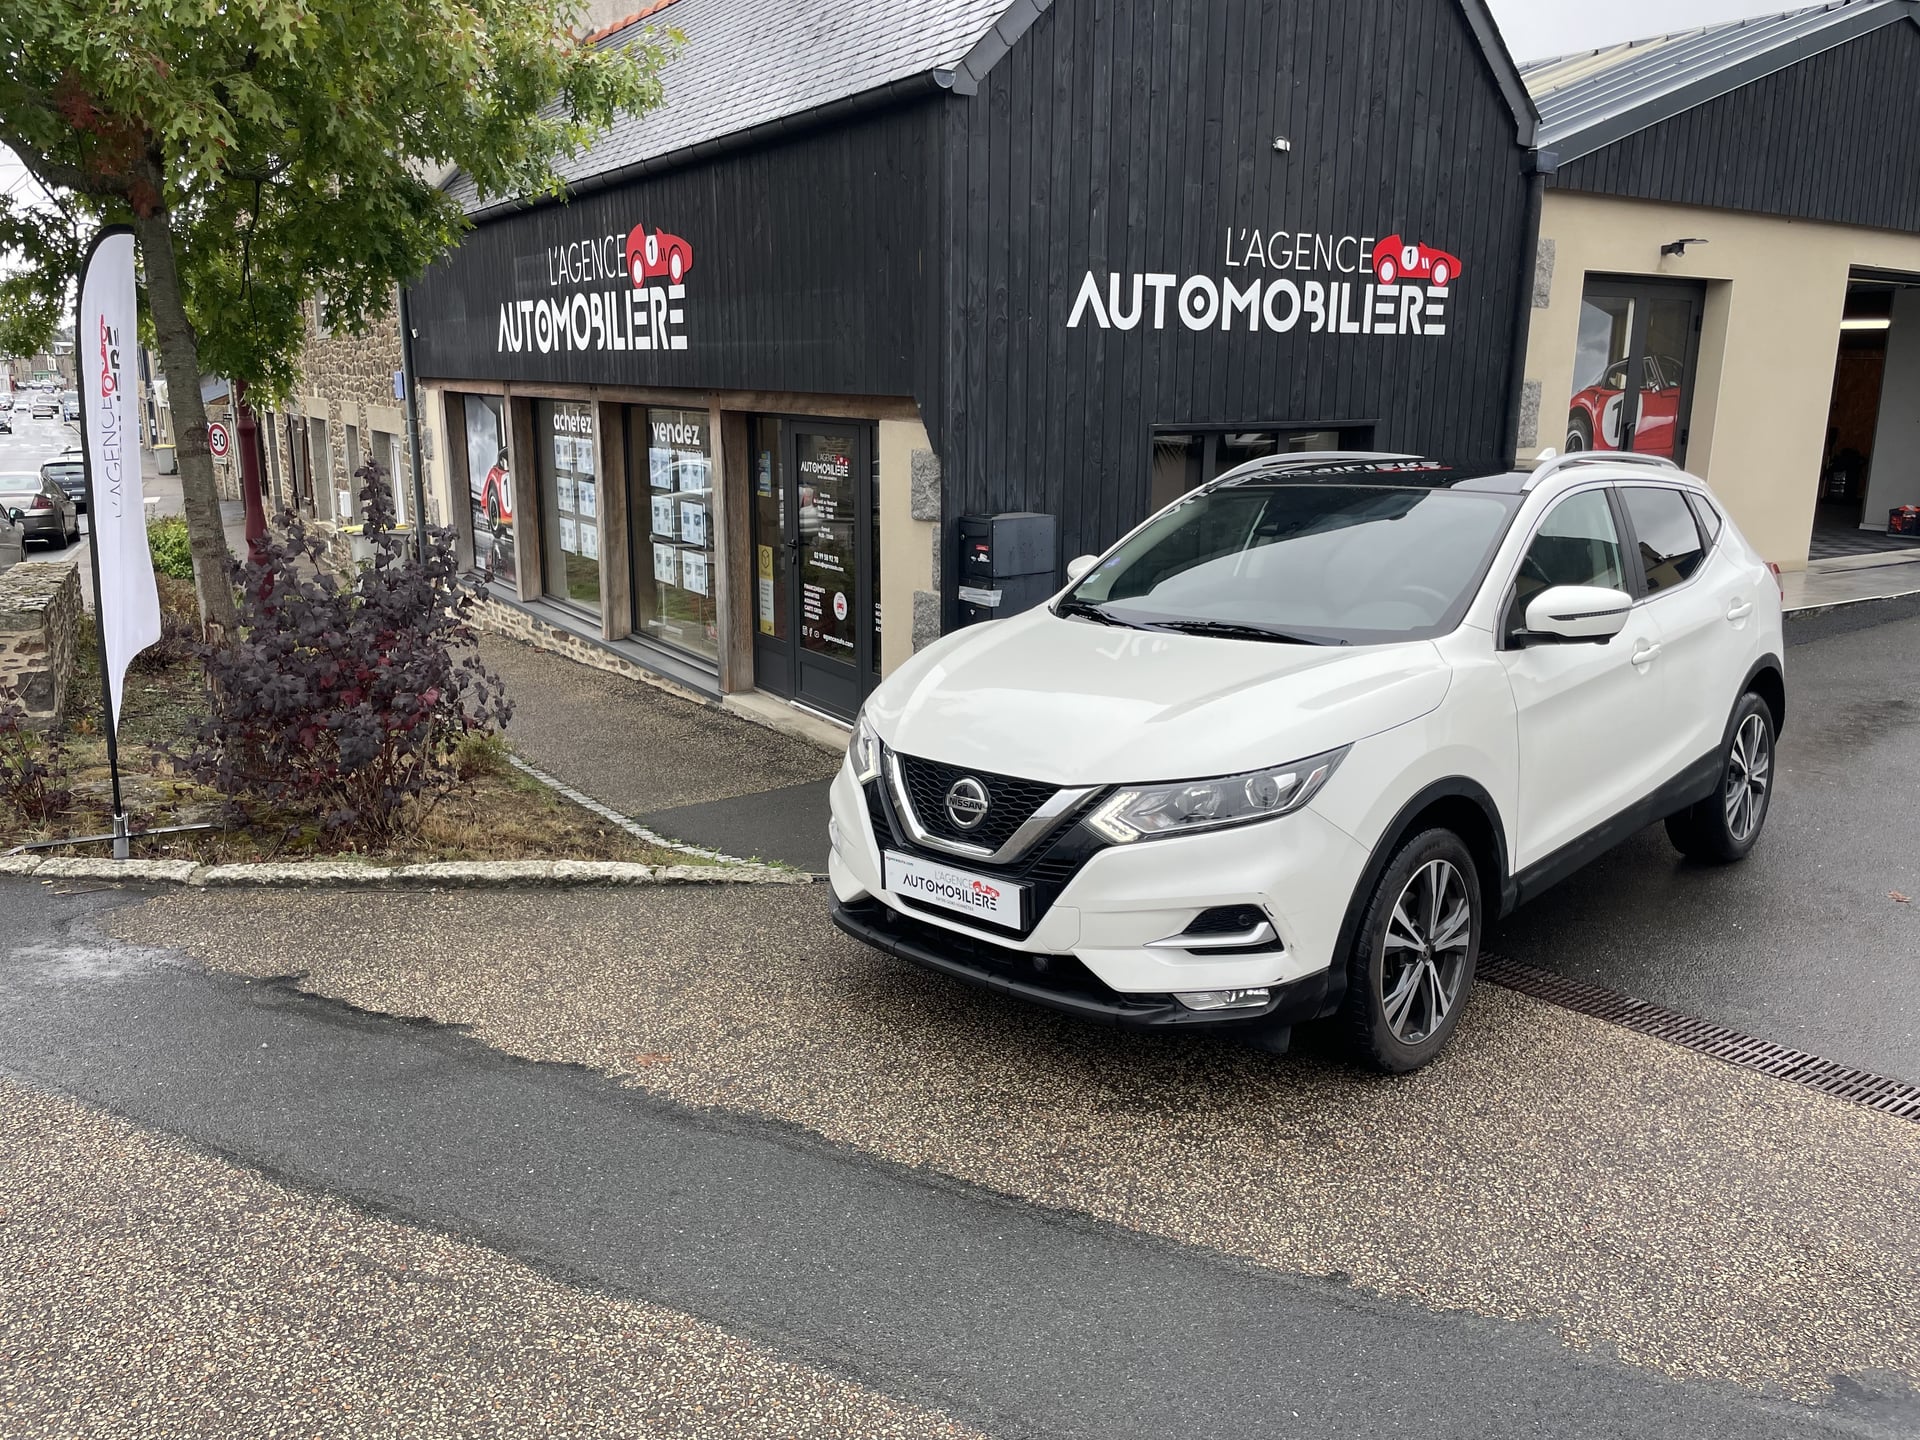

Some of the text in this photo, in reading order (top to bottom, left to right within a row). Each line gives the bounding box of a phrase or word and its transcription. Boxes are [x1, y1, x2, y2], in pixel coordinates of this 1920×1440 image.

[548, 233, 628, 286] L'AGENCE
[1225, 226, 1376, 274] L'AGENCE
[497, 283, 689, 354] AUTOMOBILIERE
[1066, 270, 1449, 335] AUTOMOBILIERE
[553, 405, 593, 434] achetez
[651, 412, 700, 446] vendez
[212, 434, 226, 447] 50
[800, 461, 848, 477] AUTOMOBILIERE
[949, 797, 982, 810] NISSAN
[903, 873, 998, 911] AUTOMOBILIERE
[934, 870, 974, 888] L'AGENCE
